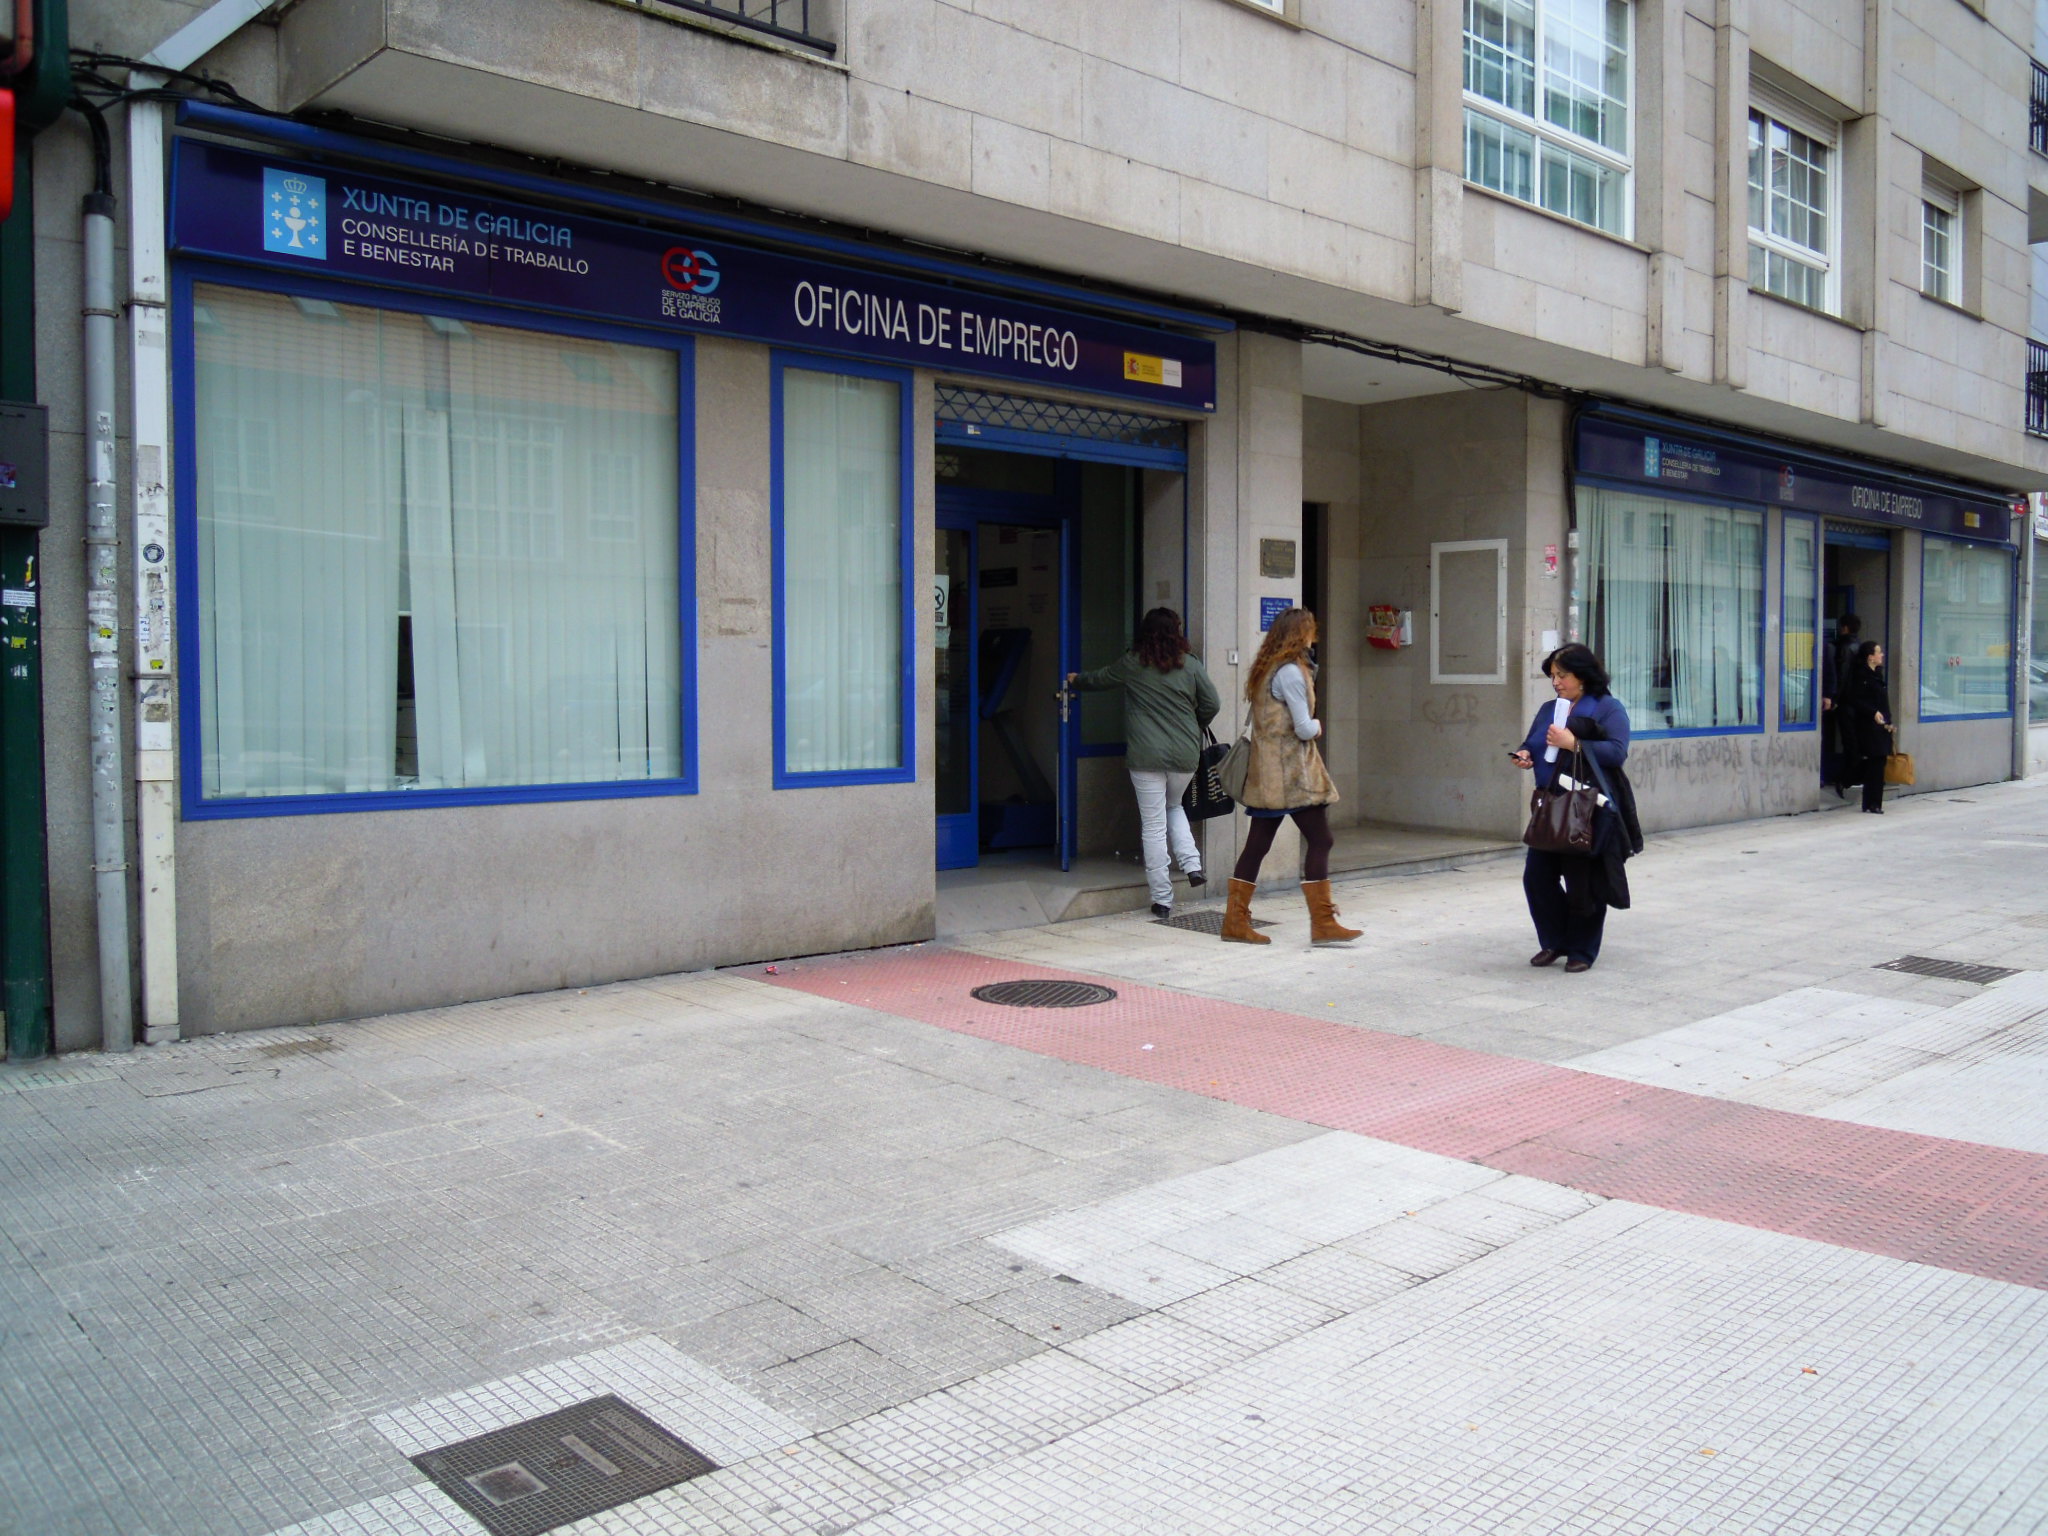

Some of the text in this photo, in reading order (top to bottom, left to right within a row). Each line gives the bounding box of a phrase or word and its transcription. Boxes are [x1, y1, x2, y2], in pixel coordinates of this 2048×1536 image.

[342, 186, 572, 249] XUNTA DE GALICIA
[342, 218, 589, 275] CONSELLERÍA DE TRABALLO
[344, 239, 455, 273] E BENESTAR
[662, 297, 720, 314] DE EMPREGO
[662, 306, 720, 324] DE GALICIA
[794, 281, 1079, 371] OFICINA DE EMPREGO
[1852, 485, 1880, 511] OFICINA
[1892, 492, 1923, 519] EMPREGO
